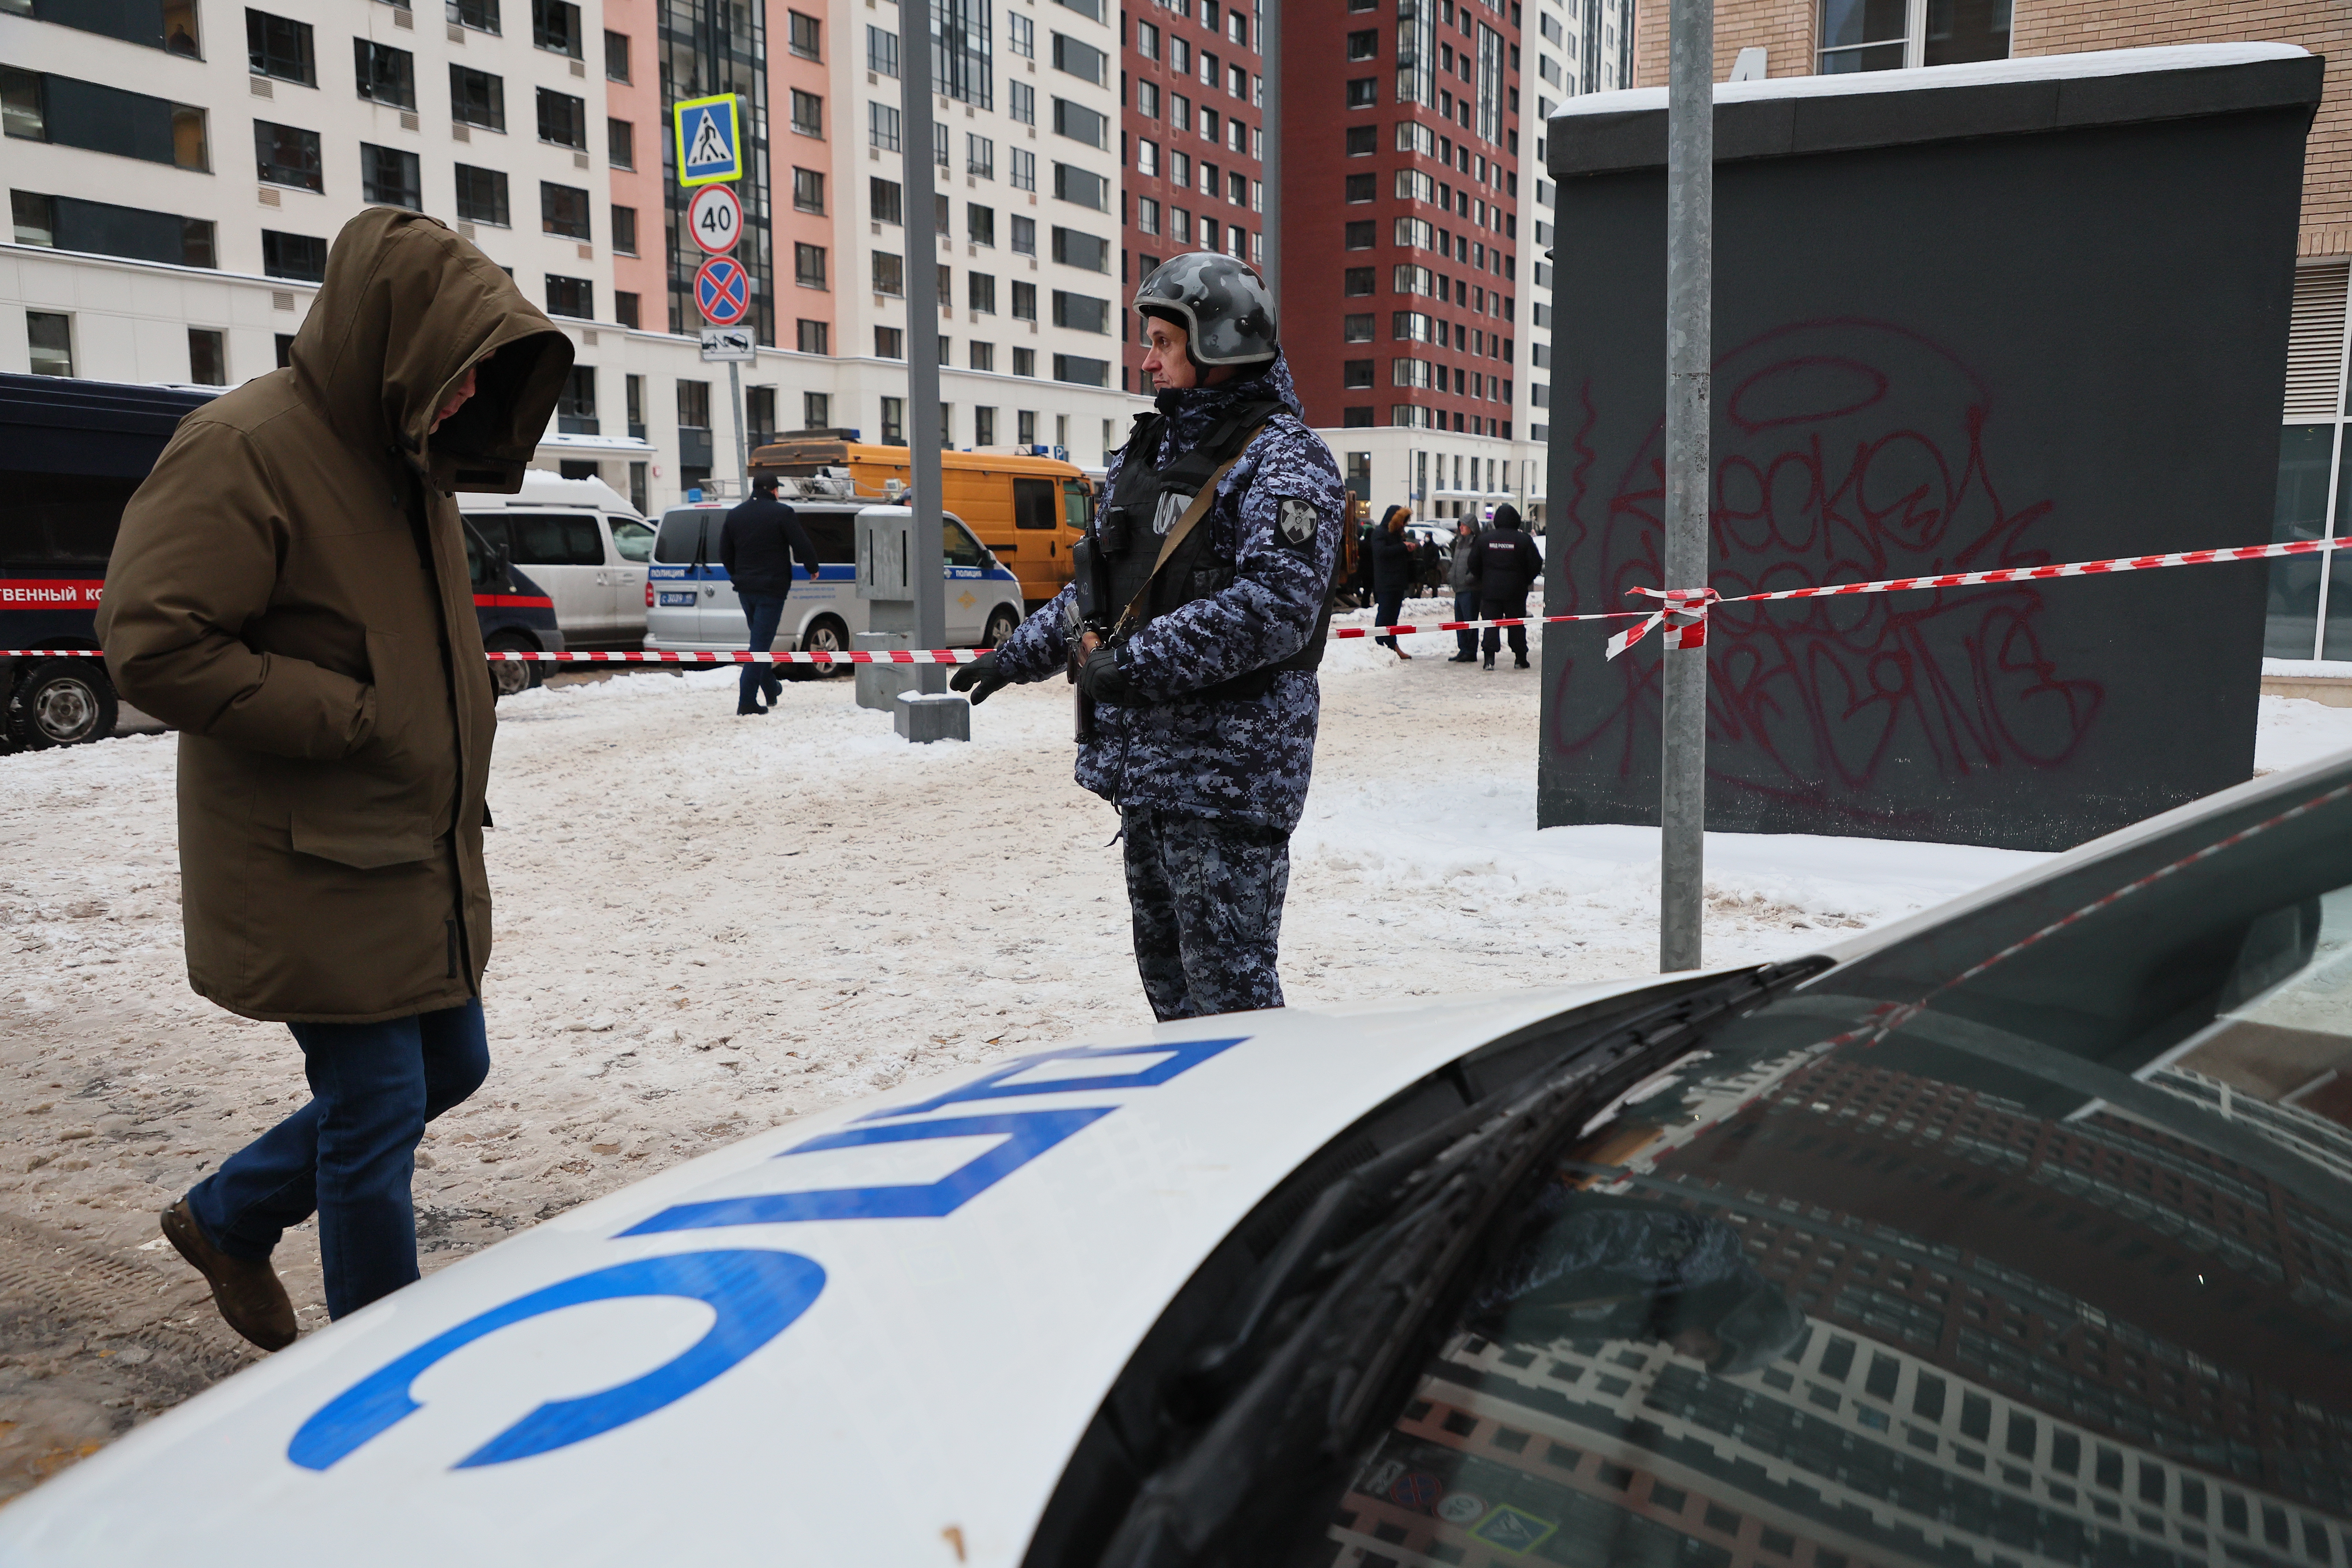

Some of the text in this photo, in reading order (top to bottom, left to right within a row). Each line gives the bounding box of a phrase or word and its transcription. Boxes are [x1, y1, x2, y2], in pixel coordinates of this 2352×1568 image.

[702, 206, 730, 232] 40
[1056, 447, 1063, 459] P
[650, 569, 685, 578] ПОЛИЦИЯ
[955, 570, 982, 578] ПОЛИЦИЯ
[1081, 582, 1088, 595] 42
